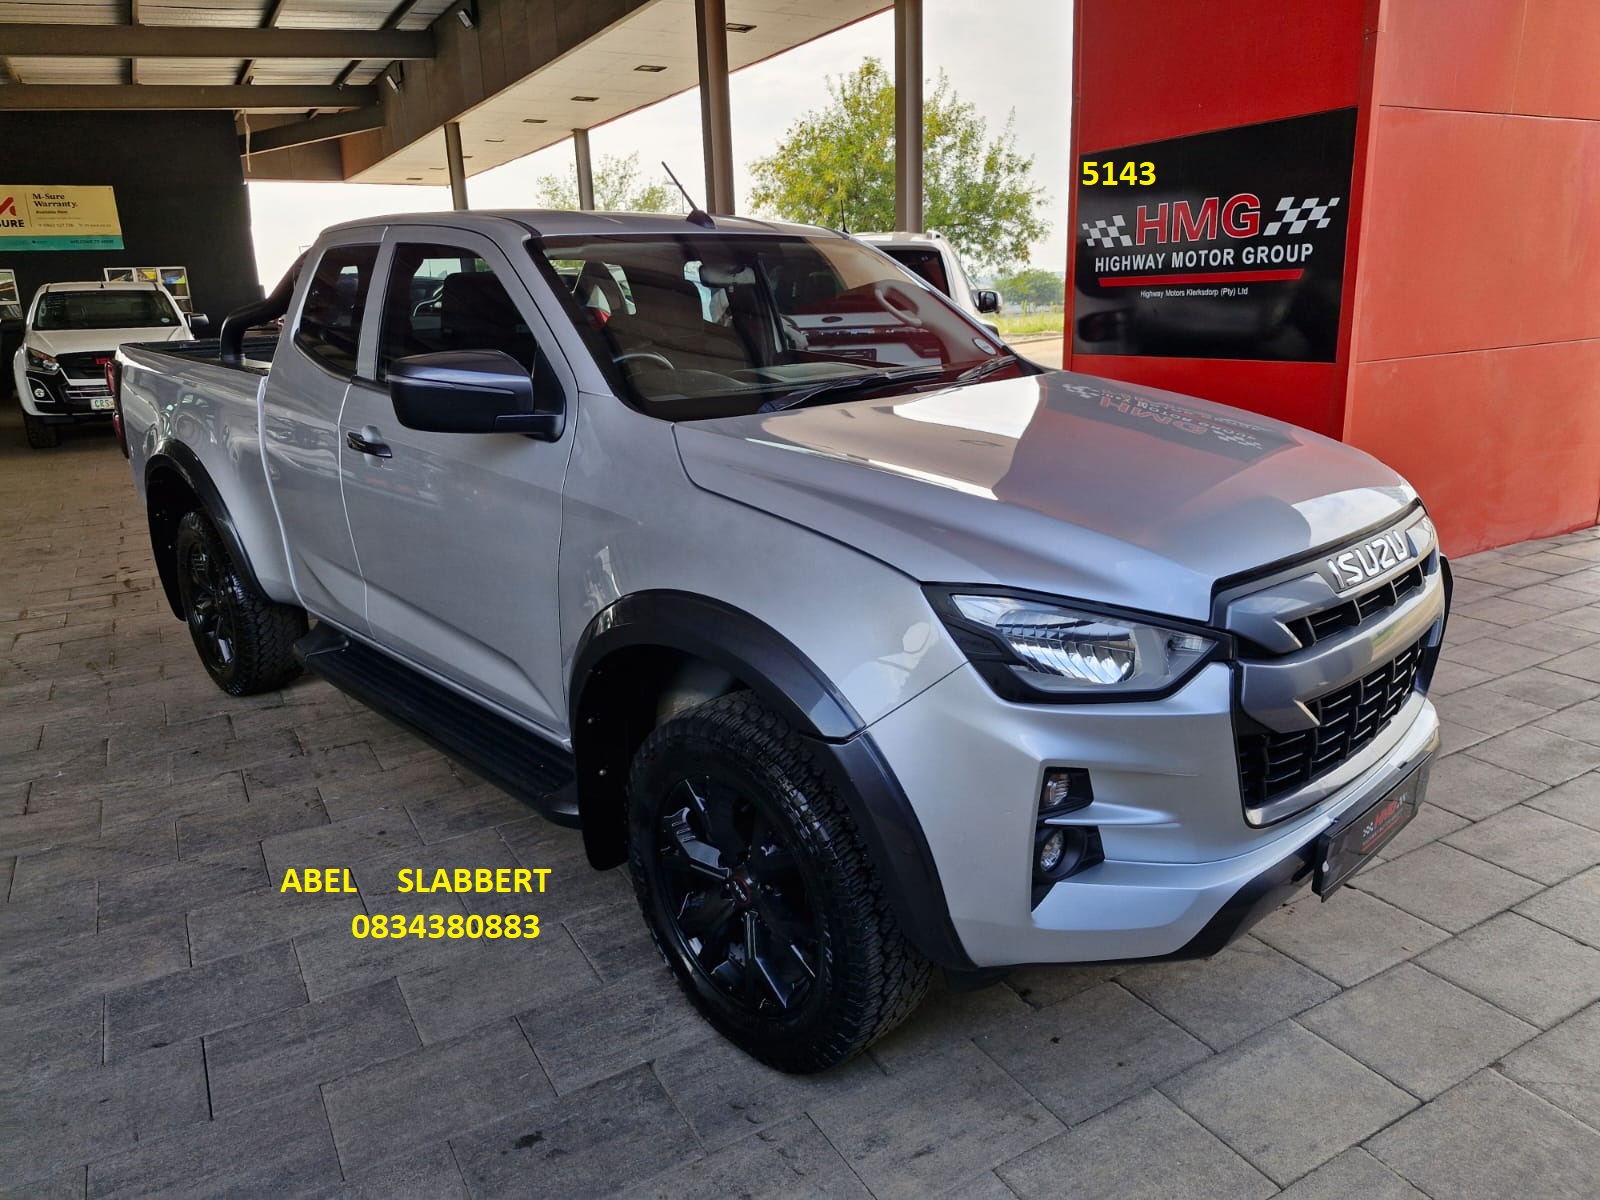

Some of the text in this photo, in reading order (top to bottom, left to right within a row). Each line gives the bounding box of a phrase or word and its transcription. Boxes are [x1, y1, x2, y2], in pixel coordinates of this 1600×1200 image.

[0, 219, 25, 228] URE
[1135, 192, 1261, 246] HMG
[1094, 243, 1313, 273] HIGHWAY MOTOR GROUP
[1140, 287, 1249, 298] Highway Motors Klerksdorp (Pty) Ltd
[1327, 530, 1408, 589] ISUZU
